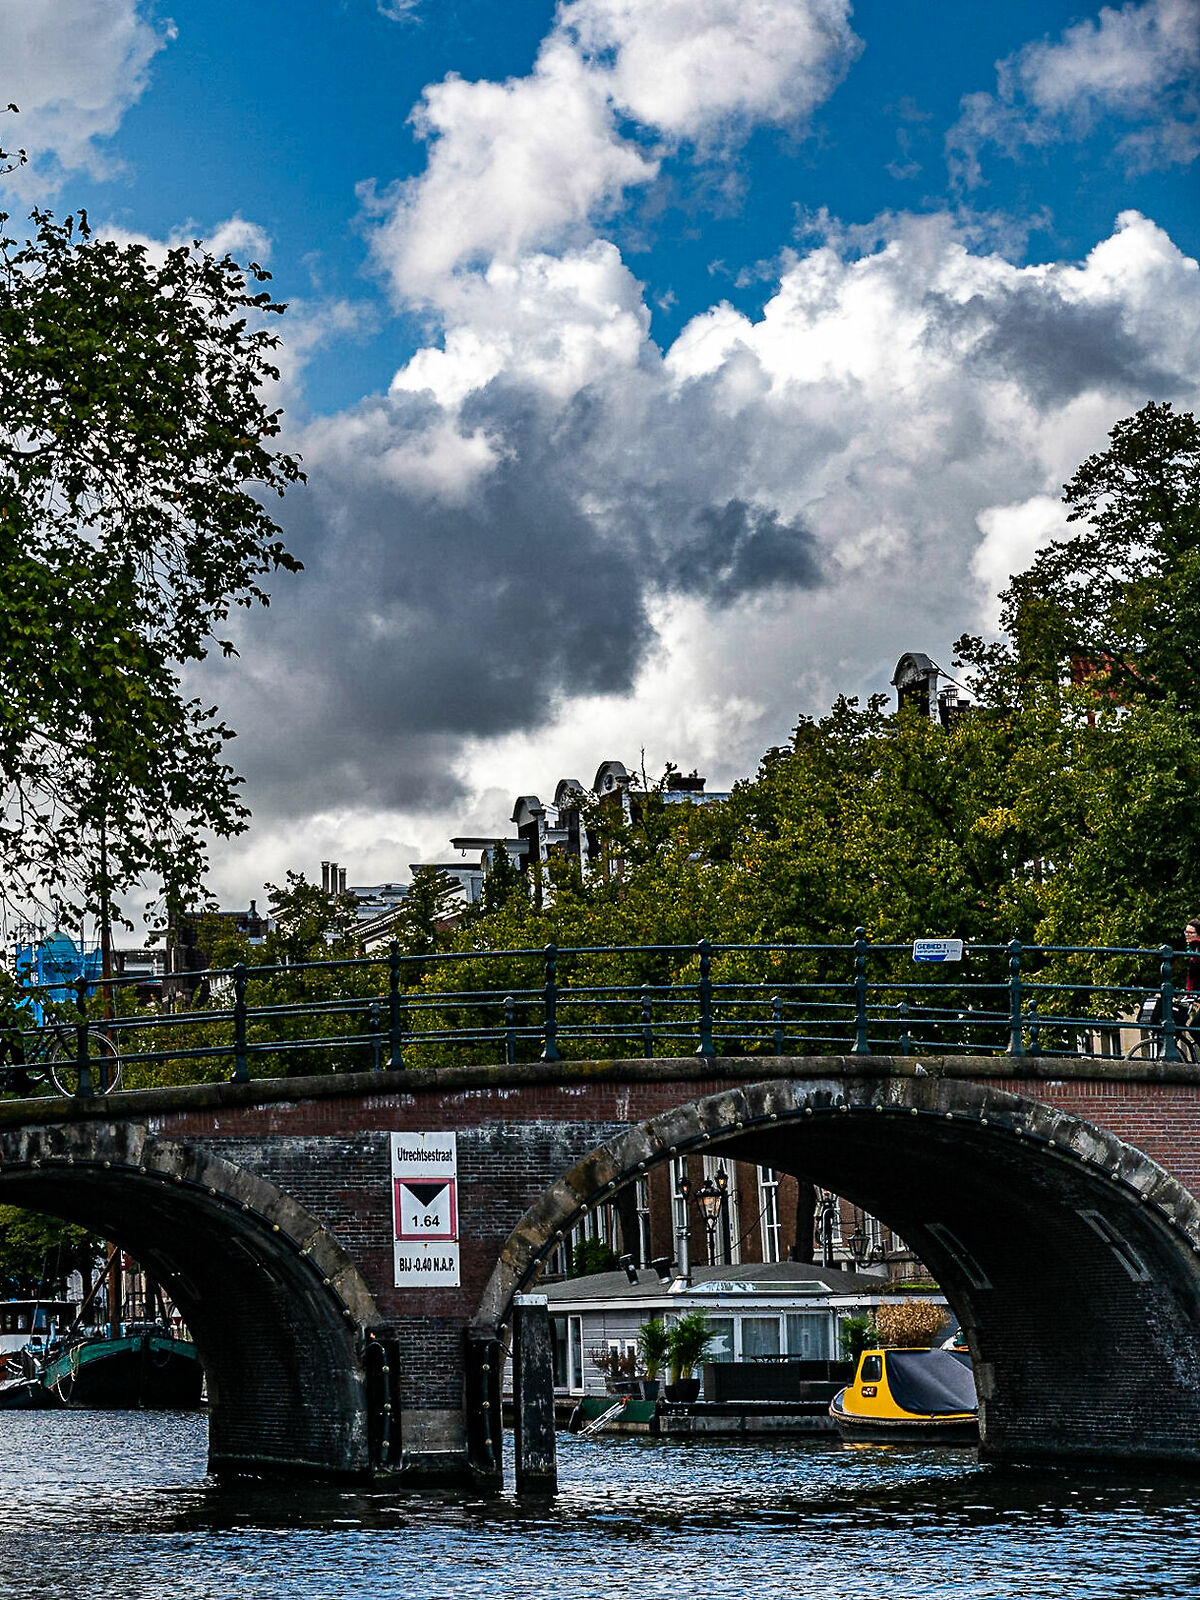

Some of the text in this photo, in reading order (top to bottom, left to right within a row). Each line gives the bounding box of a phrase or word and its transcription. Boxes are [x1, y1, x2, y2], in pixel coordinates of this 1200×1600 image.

[397, 1147, 453, 1162] Utrechtsestraat
[412, 1215, 440, 1228] 1.64
[399, 1257, 455, 1272] BIJ -0.40 N.A.P.
